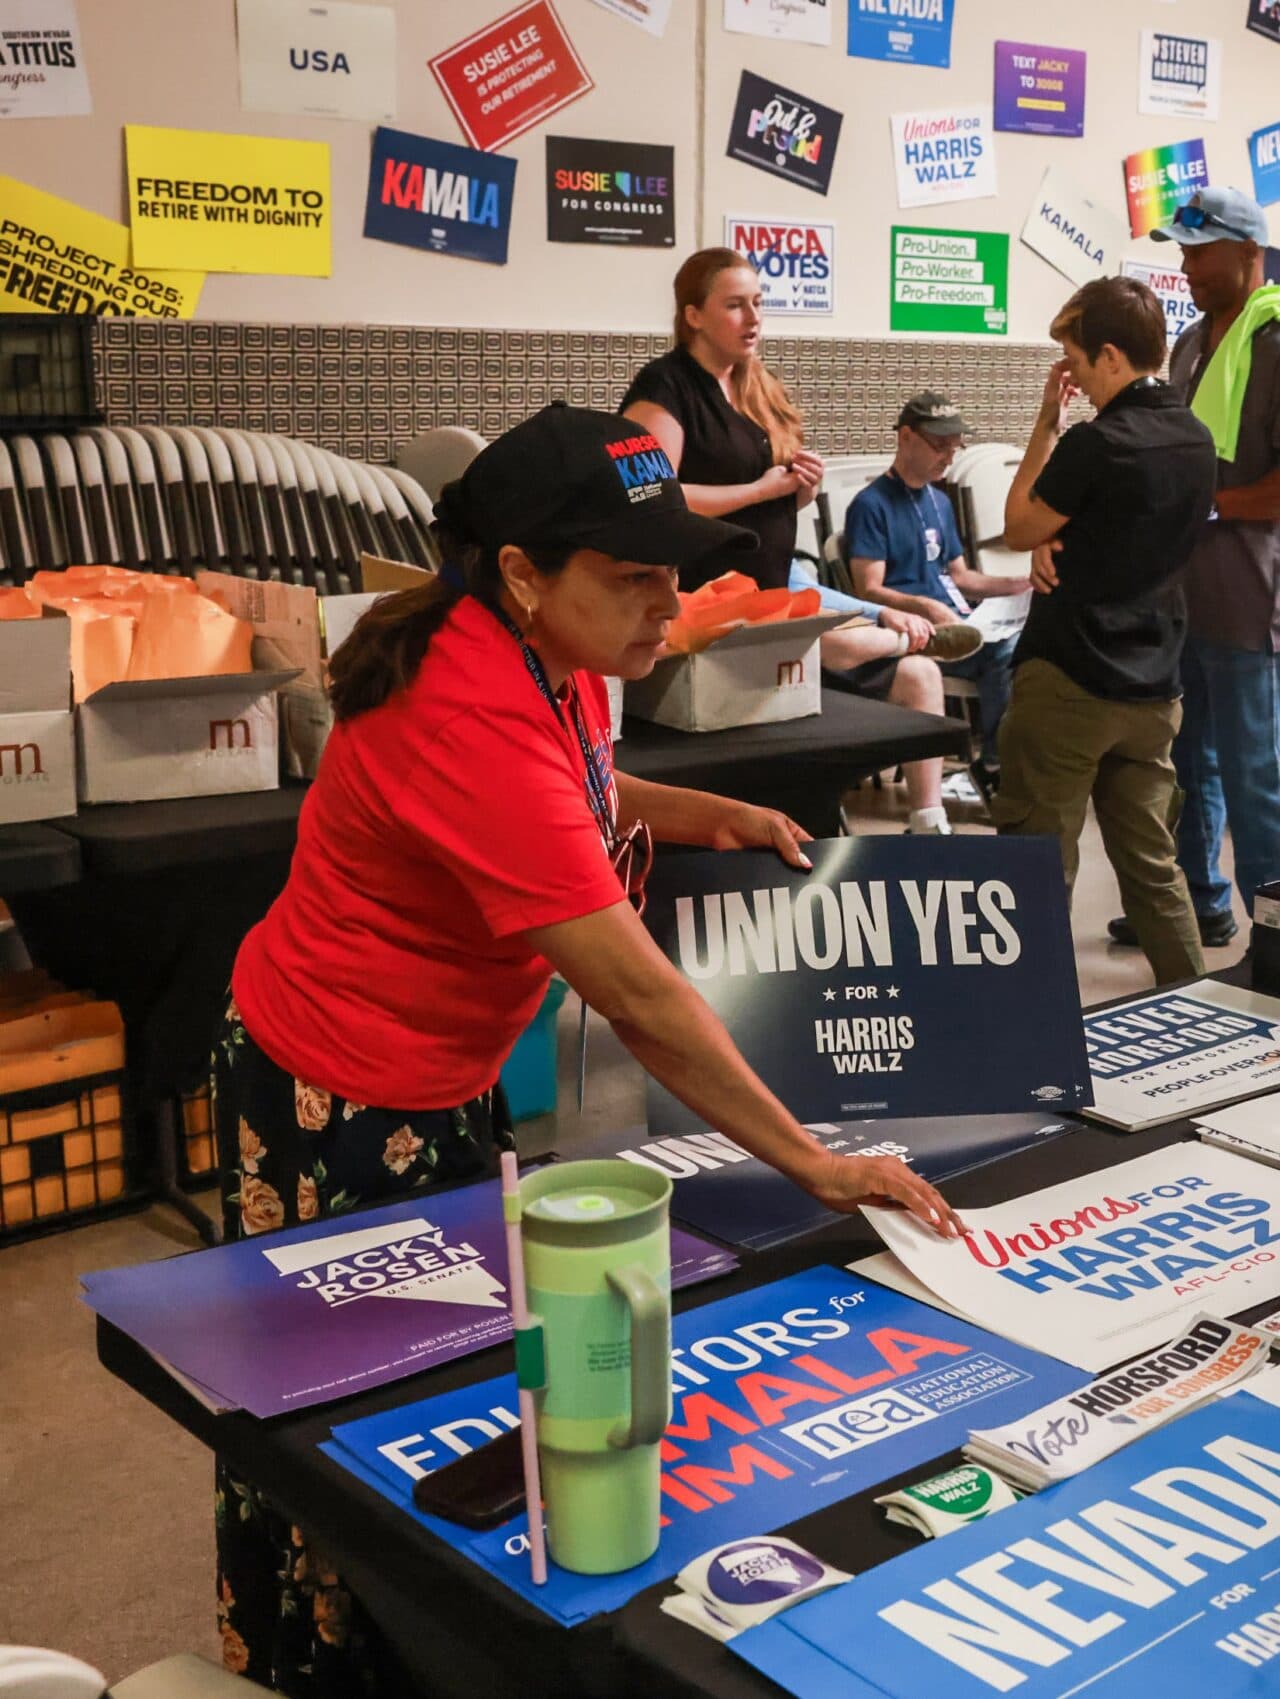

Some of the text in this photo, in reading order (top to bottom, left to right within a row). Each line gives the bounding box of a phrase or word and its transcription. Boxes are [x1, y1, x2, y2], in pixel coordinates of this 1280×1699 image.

[6, 41, 76, 68] TITUS
[289, 48, 350, 74] USA
[463, 24, 541, 83] SUSIE LEE
[1013, 55, 1069, 73] TEXT JACKY
[1160, 43, 1206, 65] STEVEN
[0, 73, 46, 90] ngress
[487, 48, 544, 90] PROTECTING
[1020, 75, 1035, 89] TO
[481, 95, 503, 115] OUR
[501, 59, 556, 102] RETIREMENT
[904, 116, 980, 141] Unions FOR
[904, 136, 983, 165] HARRIS
[555, 169, 668, 196] SUSIE LEE
[915, 161, 976, 184] WALZ
[1180, 159, 1206, 180] LEE
[137, 178, 323, 209] FREEDOM TO
[382, 158, 499, 228] KAMALA
[562, 198, 663, 215] FOR CONGRESS
[138, 201, 323, 228] RETIRE WITH DIGNITY
[735, 225, 826, 255] NATCA
[901, 236, 971, 256] Pro-Union.
[1040, 202, 1105, 266] KAMALA
[0, 239, 128, 303] SHREDDING
[1, 219, 184, 306] PROJECT 2025:
[901, 260, 975, 279] Pro-Worker.
[0, 258, 136, 317] FREEDO
[900, 284, 987, 303] Pro-Freedom.
[1149, 273, 1187, 293] NATC
[1158, 298, 1197, 319] RIS
[605, 435, 661, 460] NURSE
[615, 450, 677, 490] KAMA
[3, 774, 50, 785] OSAIC
[676, 879, 1021, 979] UNION YES
[845, 985, 878, 1001] FOR
[815, 1015, 915, 1053] HARRIS
[1088, 1015, 1258, 1076] HORSFORD
[832, 1051, 903, 1074] WALZ
[1120, 1037, 1260, 1084] FOR CONGRESS
[825, 1140, 849, 1151] OR
[964, 1176, 1212, 1269] Unions FOR
[995, 1192, 1271, 1294] HARRIS
[297, 1228, 447, 1289] JACKY
[315, 1242, 481, 1303] ROSEN
[386, 1265, 474, 1296] U.S. SENATE
[1172, 1251, 1276, 1297] AFL-CIO
[828, 1289, 866, 1315] for
[410, 1337, 436, 1352] PAID
[437, 1330, 458, 1343] FOR
[459, 1325, 472, 1336] BY
[909, 1359, 995, 1397] NATIONAL
[919, 1366, 1007, 1402] EDUCATION
[1126, 1332, 1262, 1419] FOR CONGRESS
[661, 1327, 971, 1461] MALA
[933, 1372, 1020, 1410] ASSOCIATION
[1007, 1319, 1233, 1467] Vote HORSFORD
[802, 1394, 924, 1453] nea
[660, 1444, 794, 1527] IM
[911, 1467, 979, 1499] HARRIS
[939, 1481, 982, 1505] WALZ
[731, 1553, 780, 1579] JACKY
[1209, 1583, 1257, 1610] FOR
